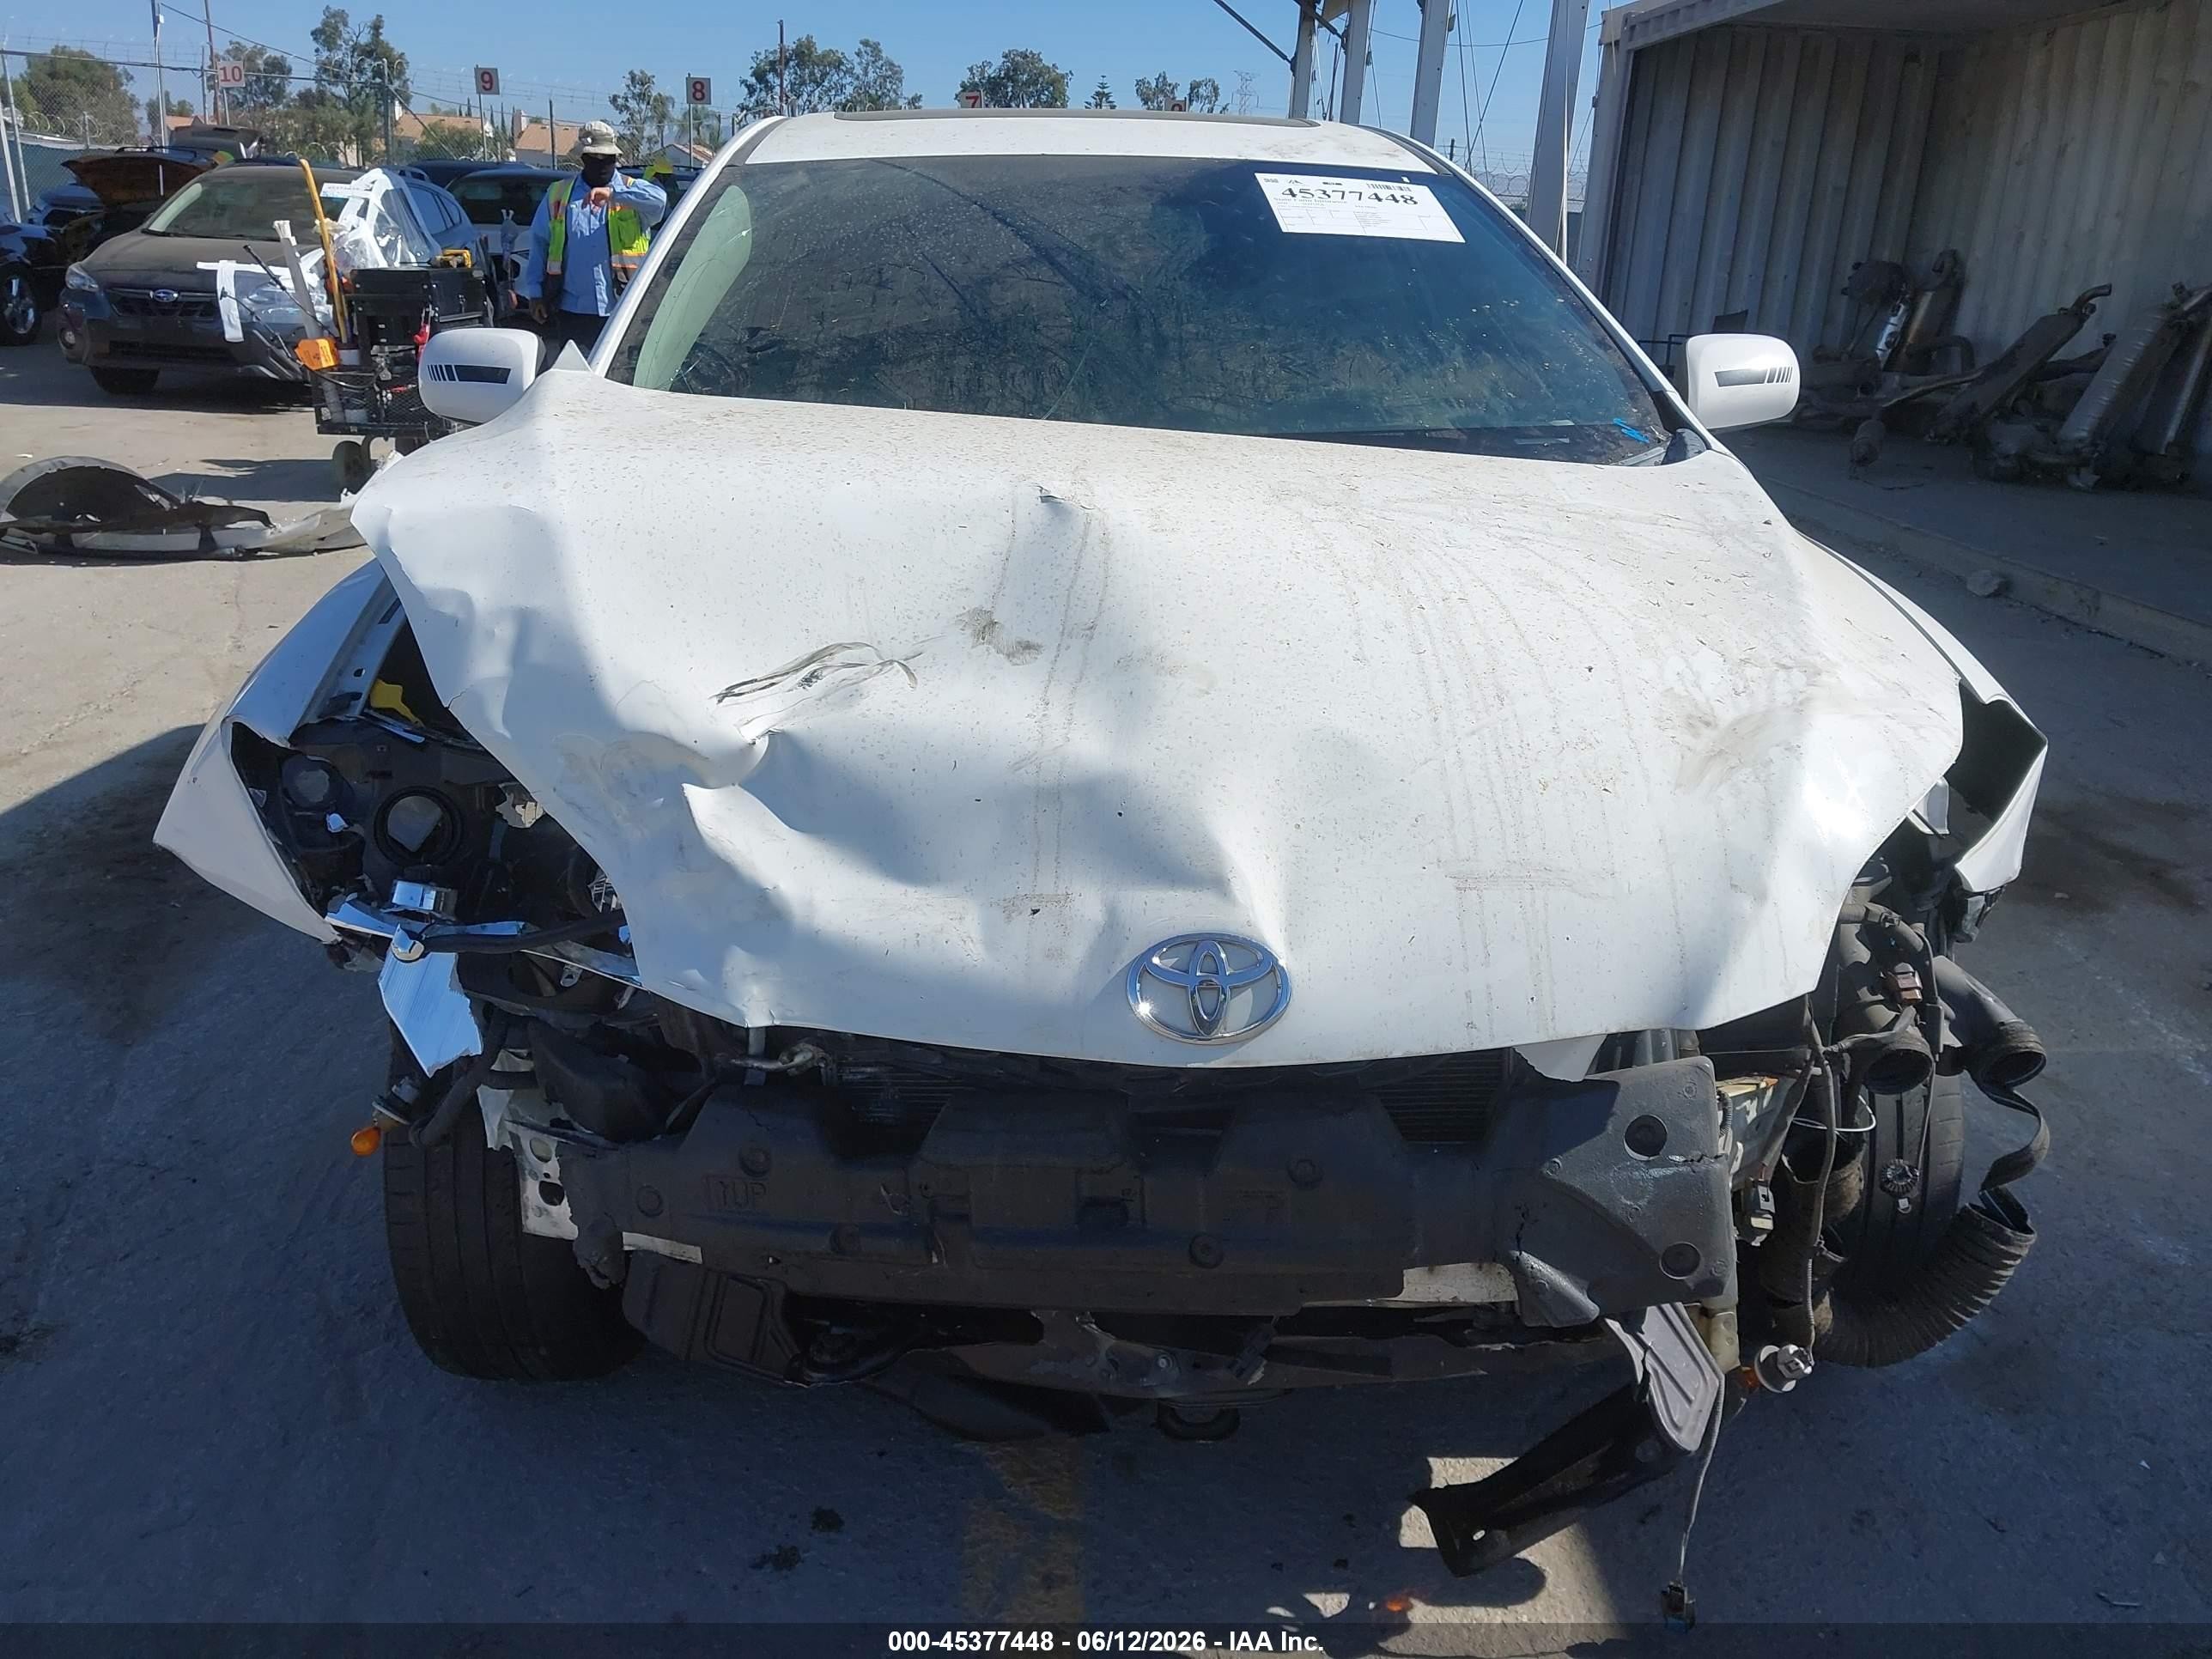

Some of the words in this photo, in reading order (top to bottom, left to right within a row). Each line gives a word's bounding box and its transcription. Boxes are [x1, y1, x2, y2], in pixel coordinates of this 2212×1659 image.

[219, 65, 242, 82] 10
[481, 71, 494, 91] 9
[692, 81, 706, 100] 8
[965, 95, 980, 109] 7
[1280, 187, 1419, 205] 45377448
